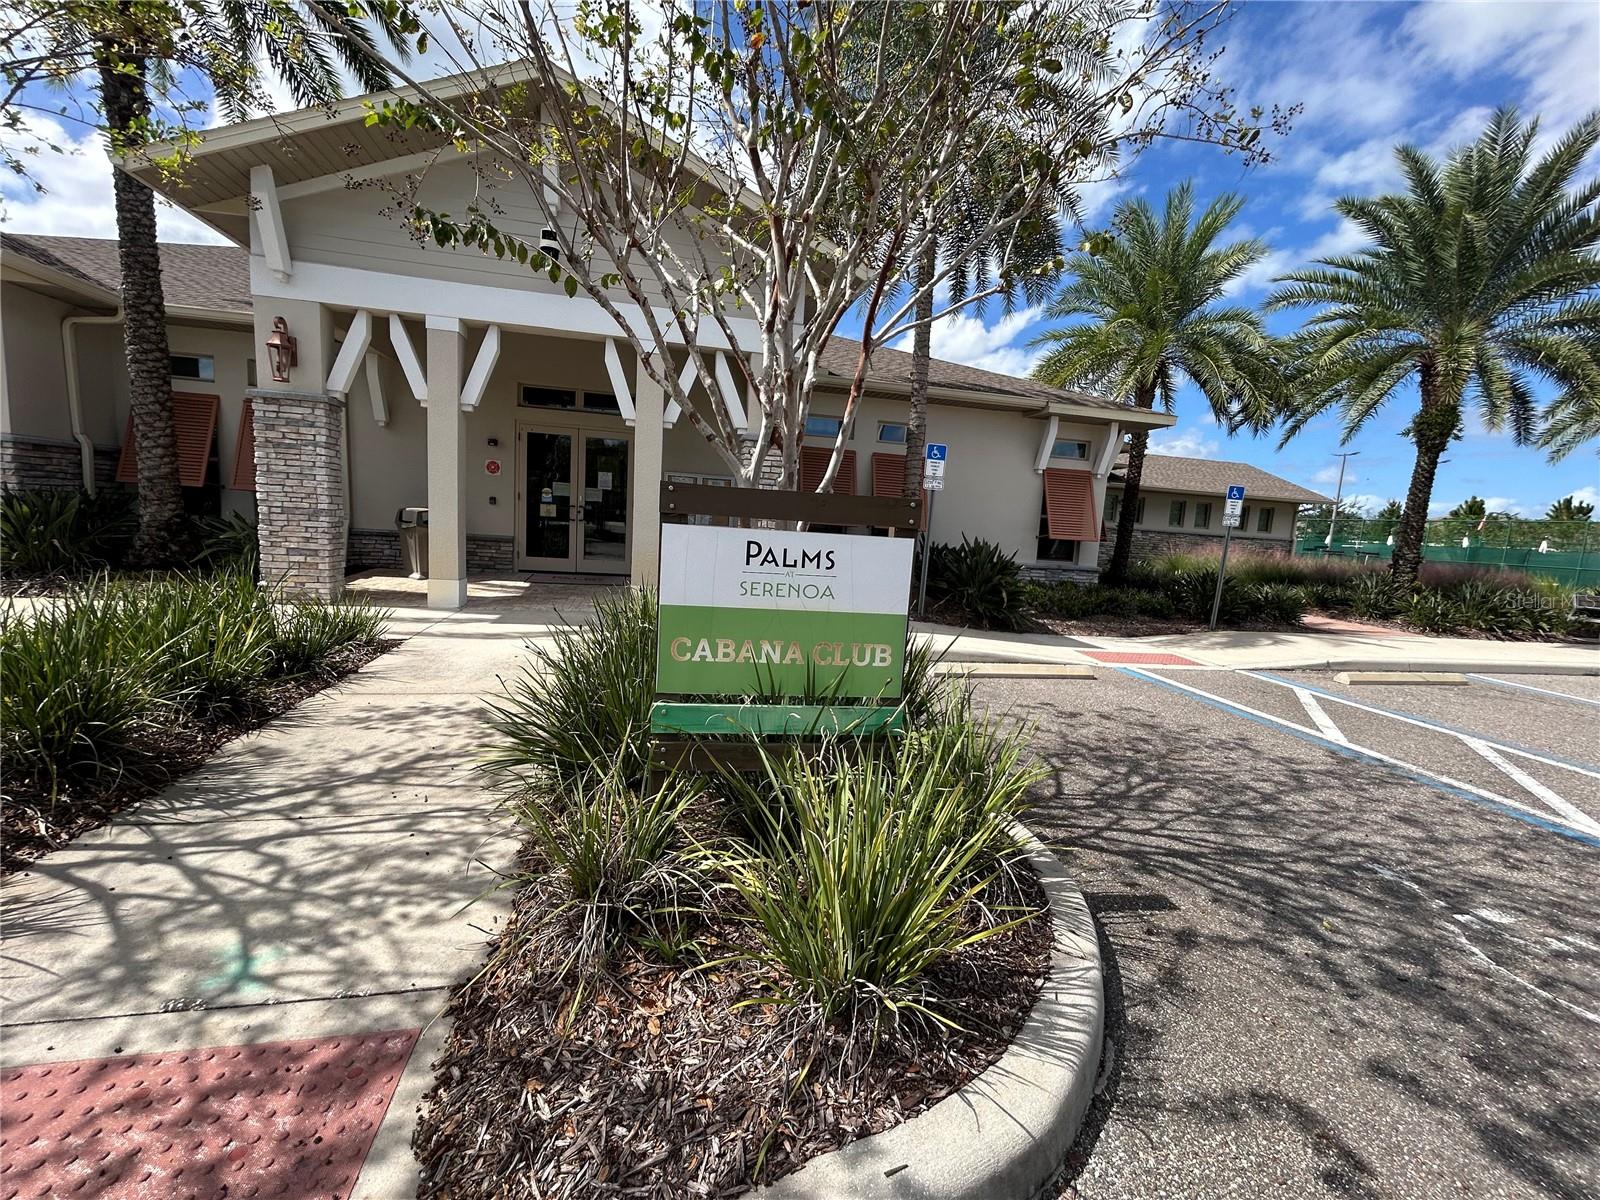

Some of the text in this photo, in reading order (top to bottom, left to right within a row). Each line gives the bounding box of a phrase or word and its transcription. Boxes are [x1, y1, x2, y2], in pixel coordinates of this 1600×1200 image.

[745, 540, 836, 570] PALMS
[785, 570, 795, 578] AT
[740, 580, 836, 600] SERENOA
[670, 636, 893, 667] CABANA CLUB
